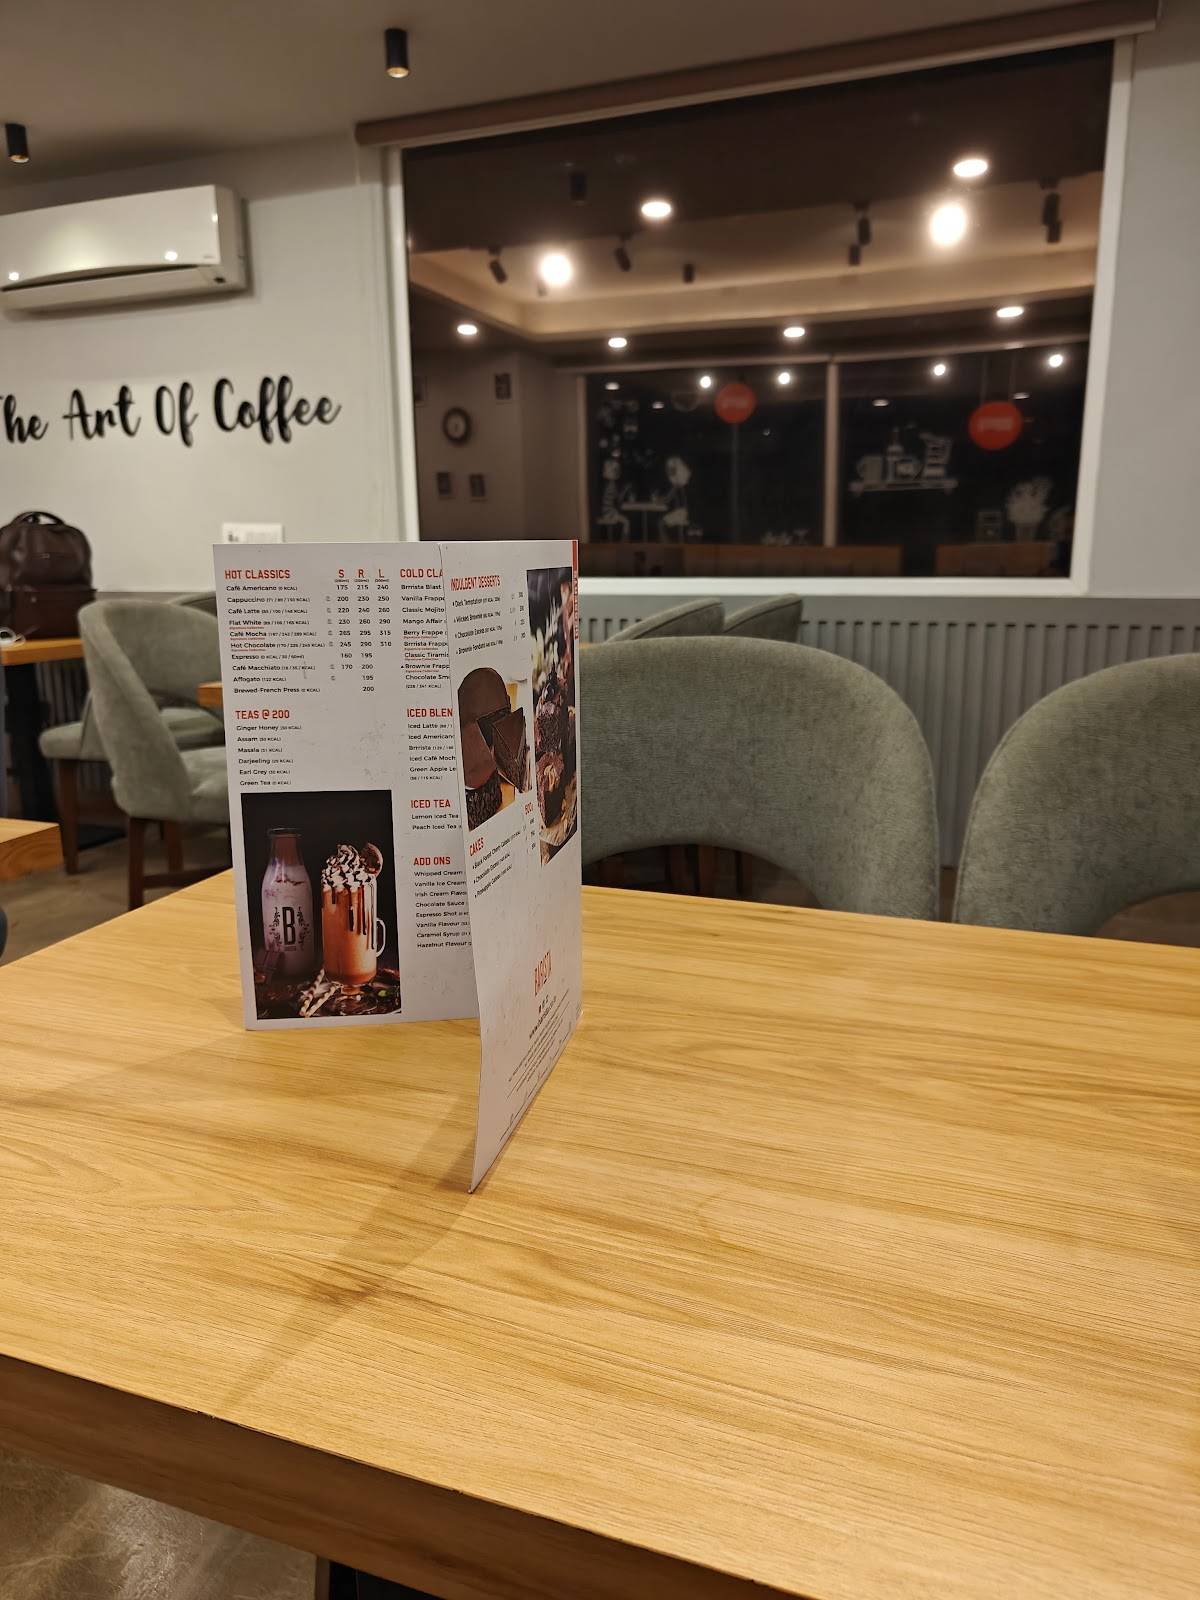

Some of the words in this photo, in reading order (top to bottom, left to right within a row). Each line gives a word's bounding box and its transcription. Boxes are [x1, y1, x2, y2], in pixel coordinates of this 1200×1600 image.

[0, 394, 48, 443] he
[62, 385, 141, 440] Art
[155, 381, 199, 447] Of
[214, 375, 342, 444] Coffee
[225, 569, 242, 579] HOT
[245, 569, 290, 579] CLASSICS
[338, 569, 344, 578] S
[358, 569, 364, 578] R
[378, 569, 385, 578] L
[400, 568, 424, 578] COLD
[450, 577, 477, 591] INDULGENT
[478, 575, 500, 588] DESSERTS
[235, 710, 259, 719] TEAS
[262, 709, 270, 719] @
[272, 709, 290, 719] 200
[407, 708, 427, 718] ICED
[429, 708, 453, 717] BLEN
[411, 799, 431, 809] ICED
[433, 799, 451, 808] TEA
[469, 837, 484, 857] CAKES
[413, 857, 431, 866] ADD
[433, 856, 451, 865] ONS
[282, 906, 296, 945] B
